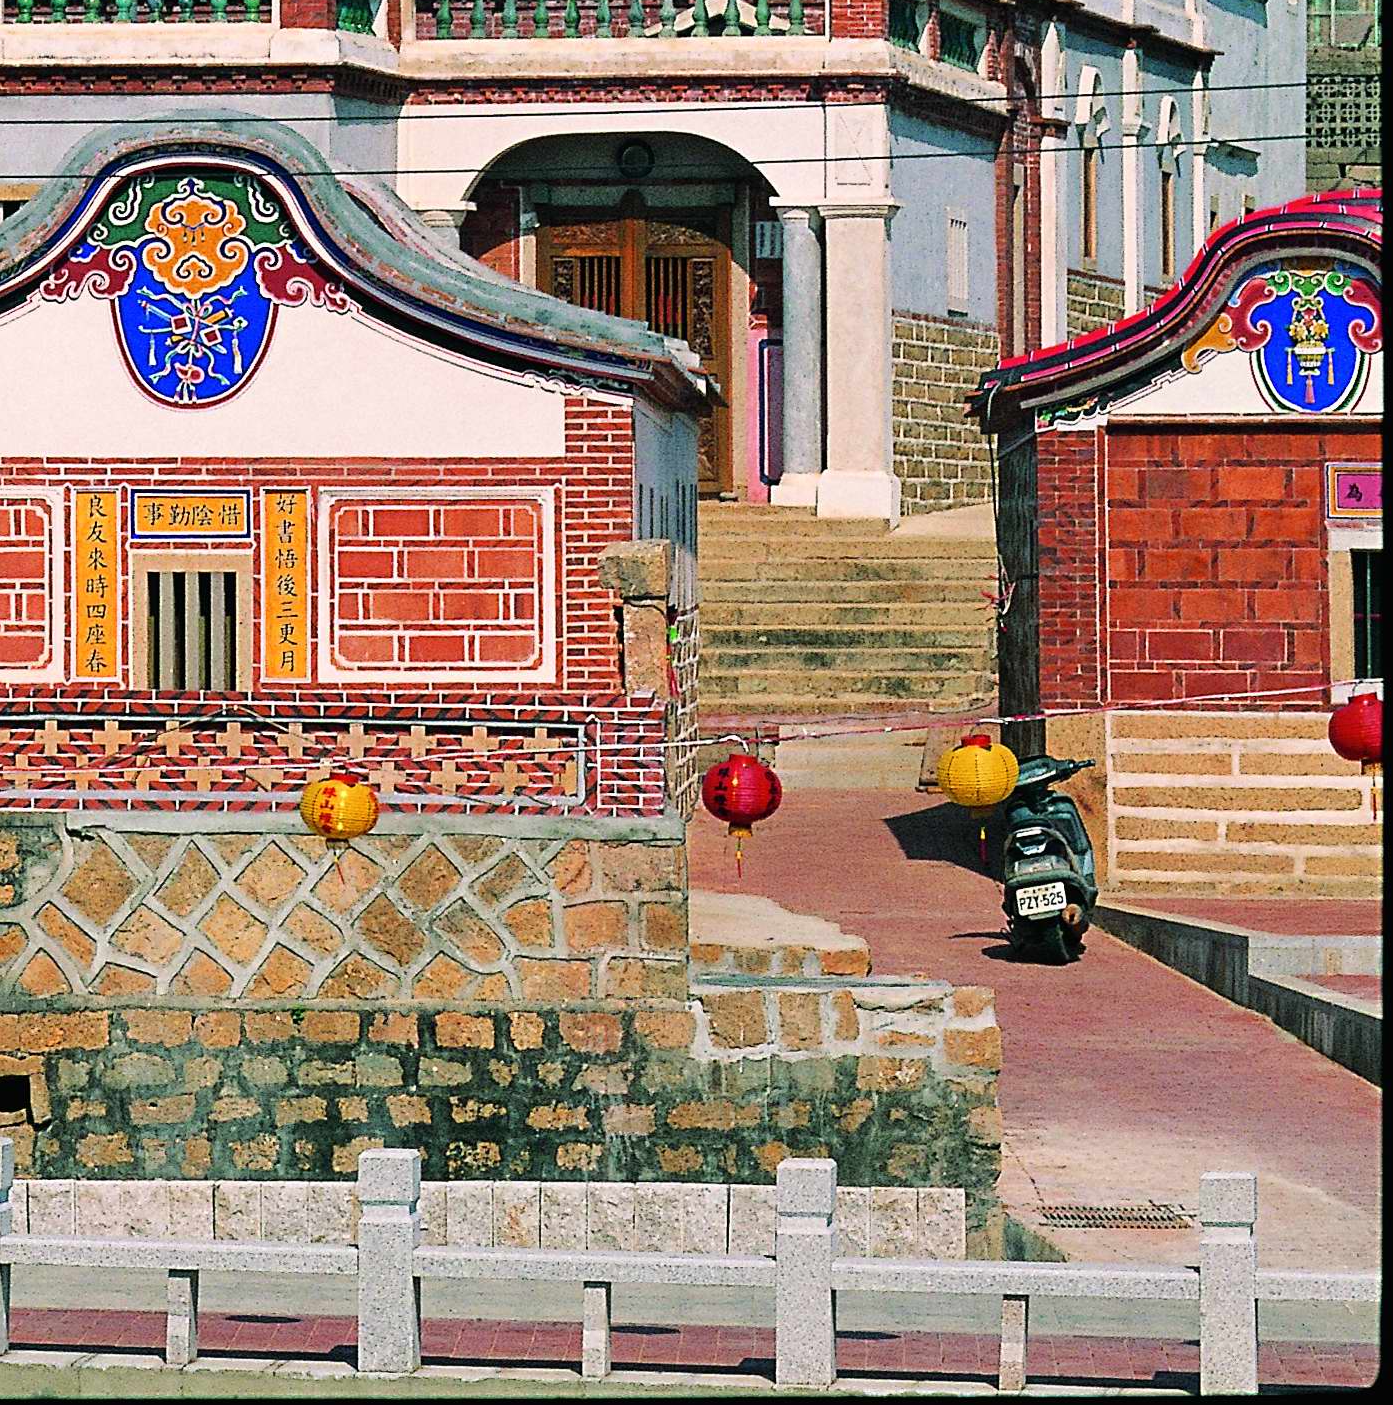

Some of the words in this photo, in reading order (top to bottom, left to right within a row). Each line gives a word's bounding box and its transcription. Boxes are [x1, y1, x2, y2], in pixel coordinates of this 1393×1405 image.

[84, 494, 109, 674] 良友來時四座春
[273, 493, 299, 673] 好書悟後三更月
[1019, 891, 1064, 911] PZY-525
